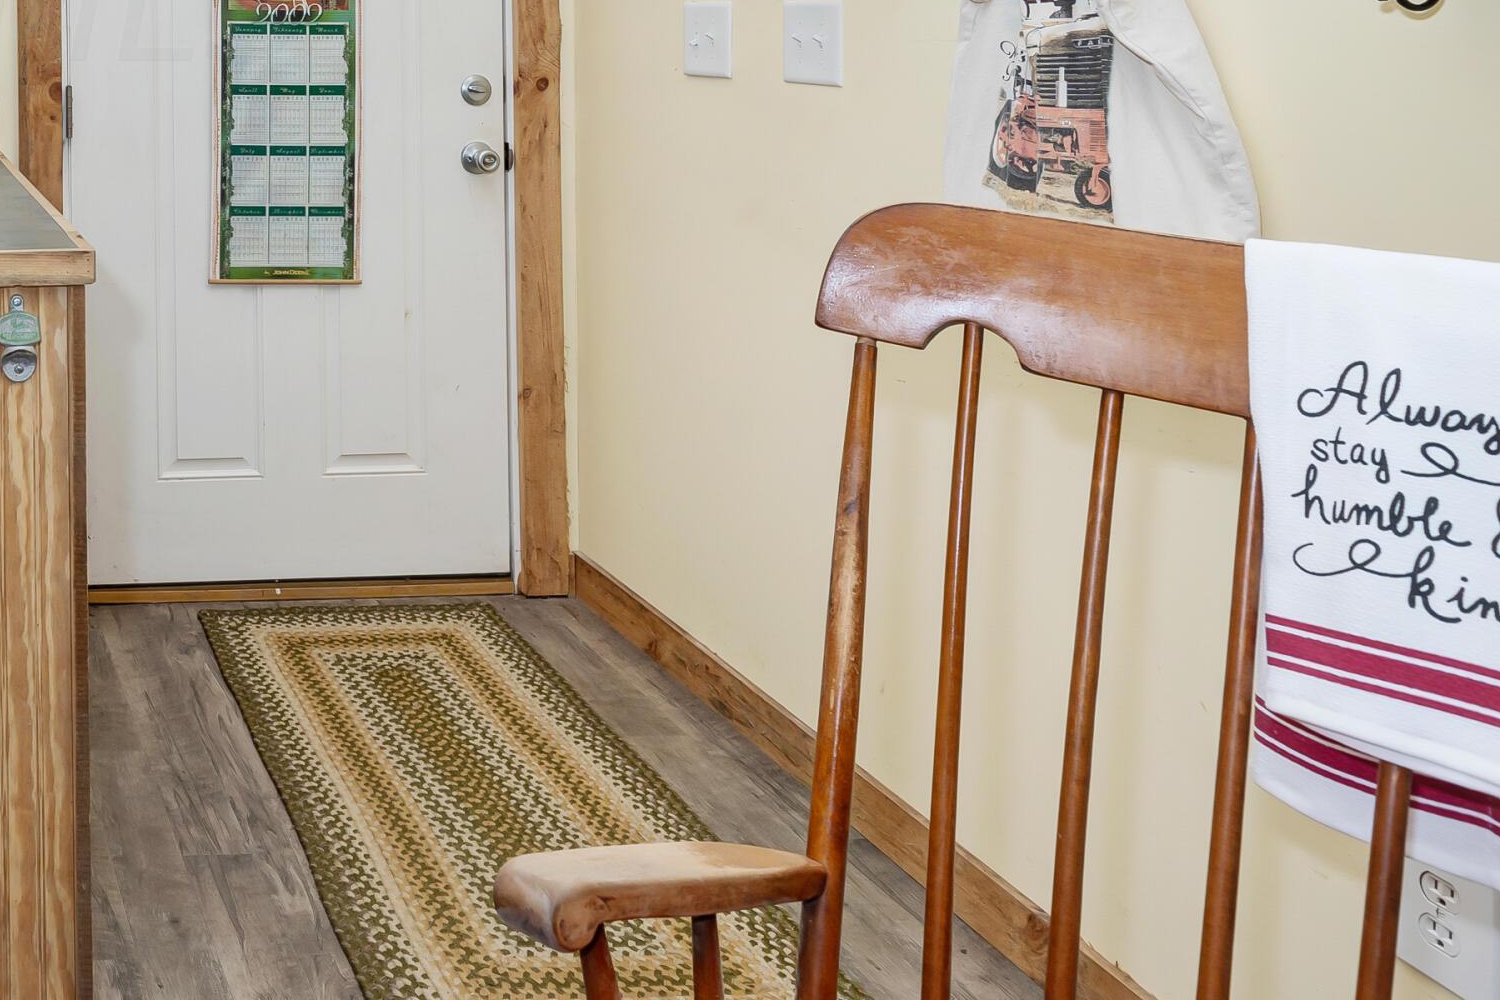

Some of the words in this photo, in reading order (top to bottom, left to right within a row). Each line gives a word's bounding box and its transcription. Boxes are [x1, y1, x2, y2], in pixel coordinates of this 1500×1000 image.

[256, 3, 323, 25] 2002
[1310, 426, 1391, 484] stay
[1290, 464, 1473, 547] humble
